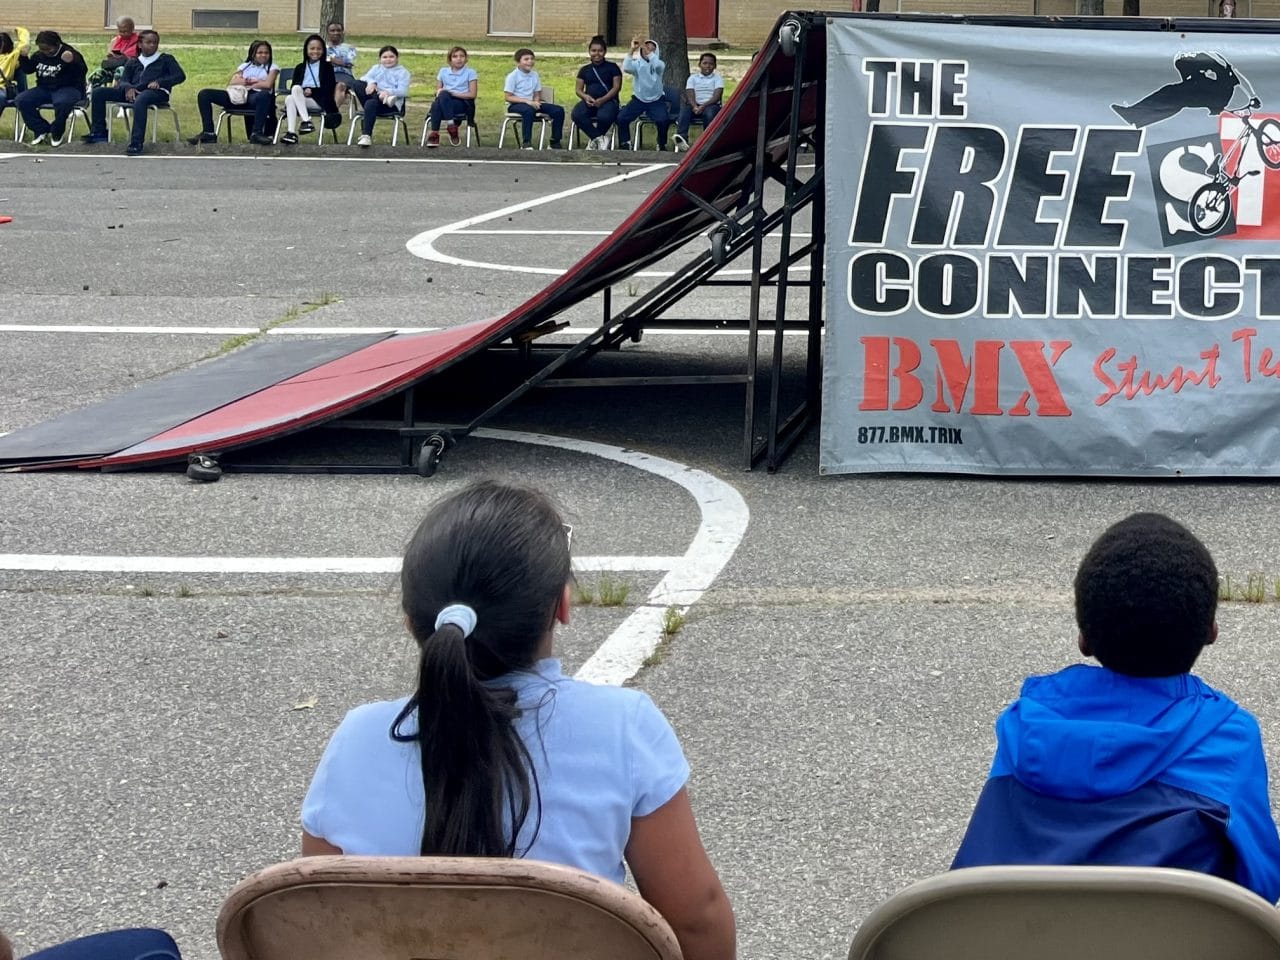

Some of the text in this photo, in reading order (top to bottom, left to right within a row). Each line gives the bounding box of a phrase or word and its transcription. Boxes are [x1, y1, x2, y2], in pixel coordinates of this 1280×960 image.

[862, 57, 969, 119] THE
[858, 335, 1073, 417] BMX
[1093, 347, 1222, 406] Stunt
[857, 426, 963, 444] 877.BMX.TRIX
